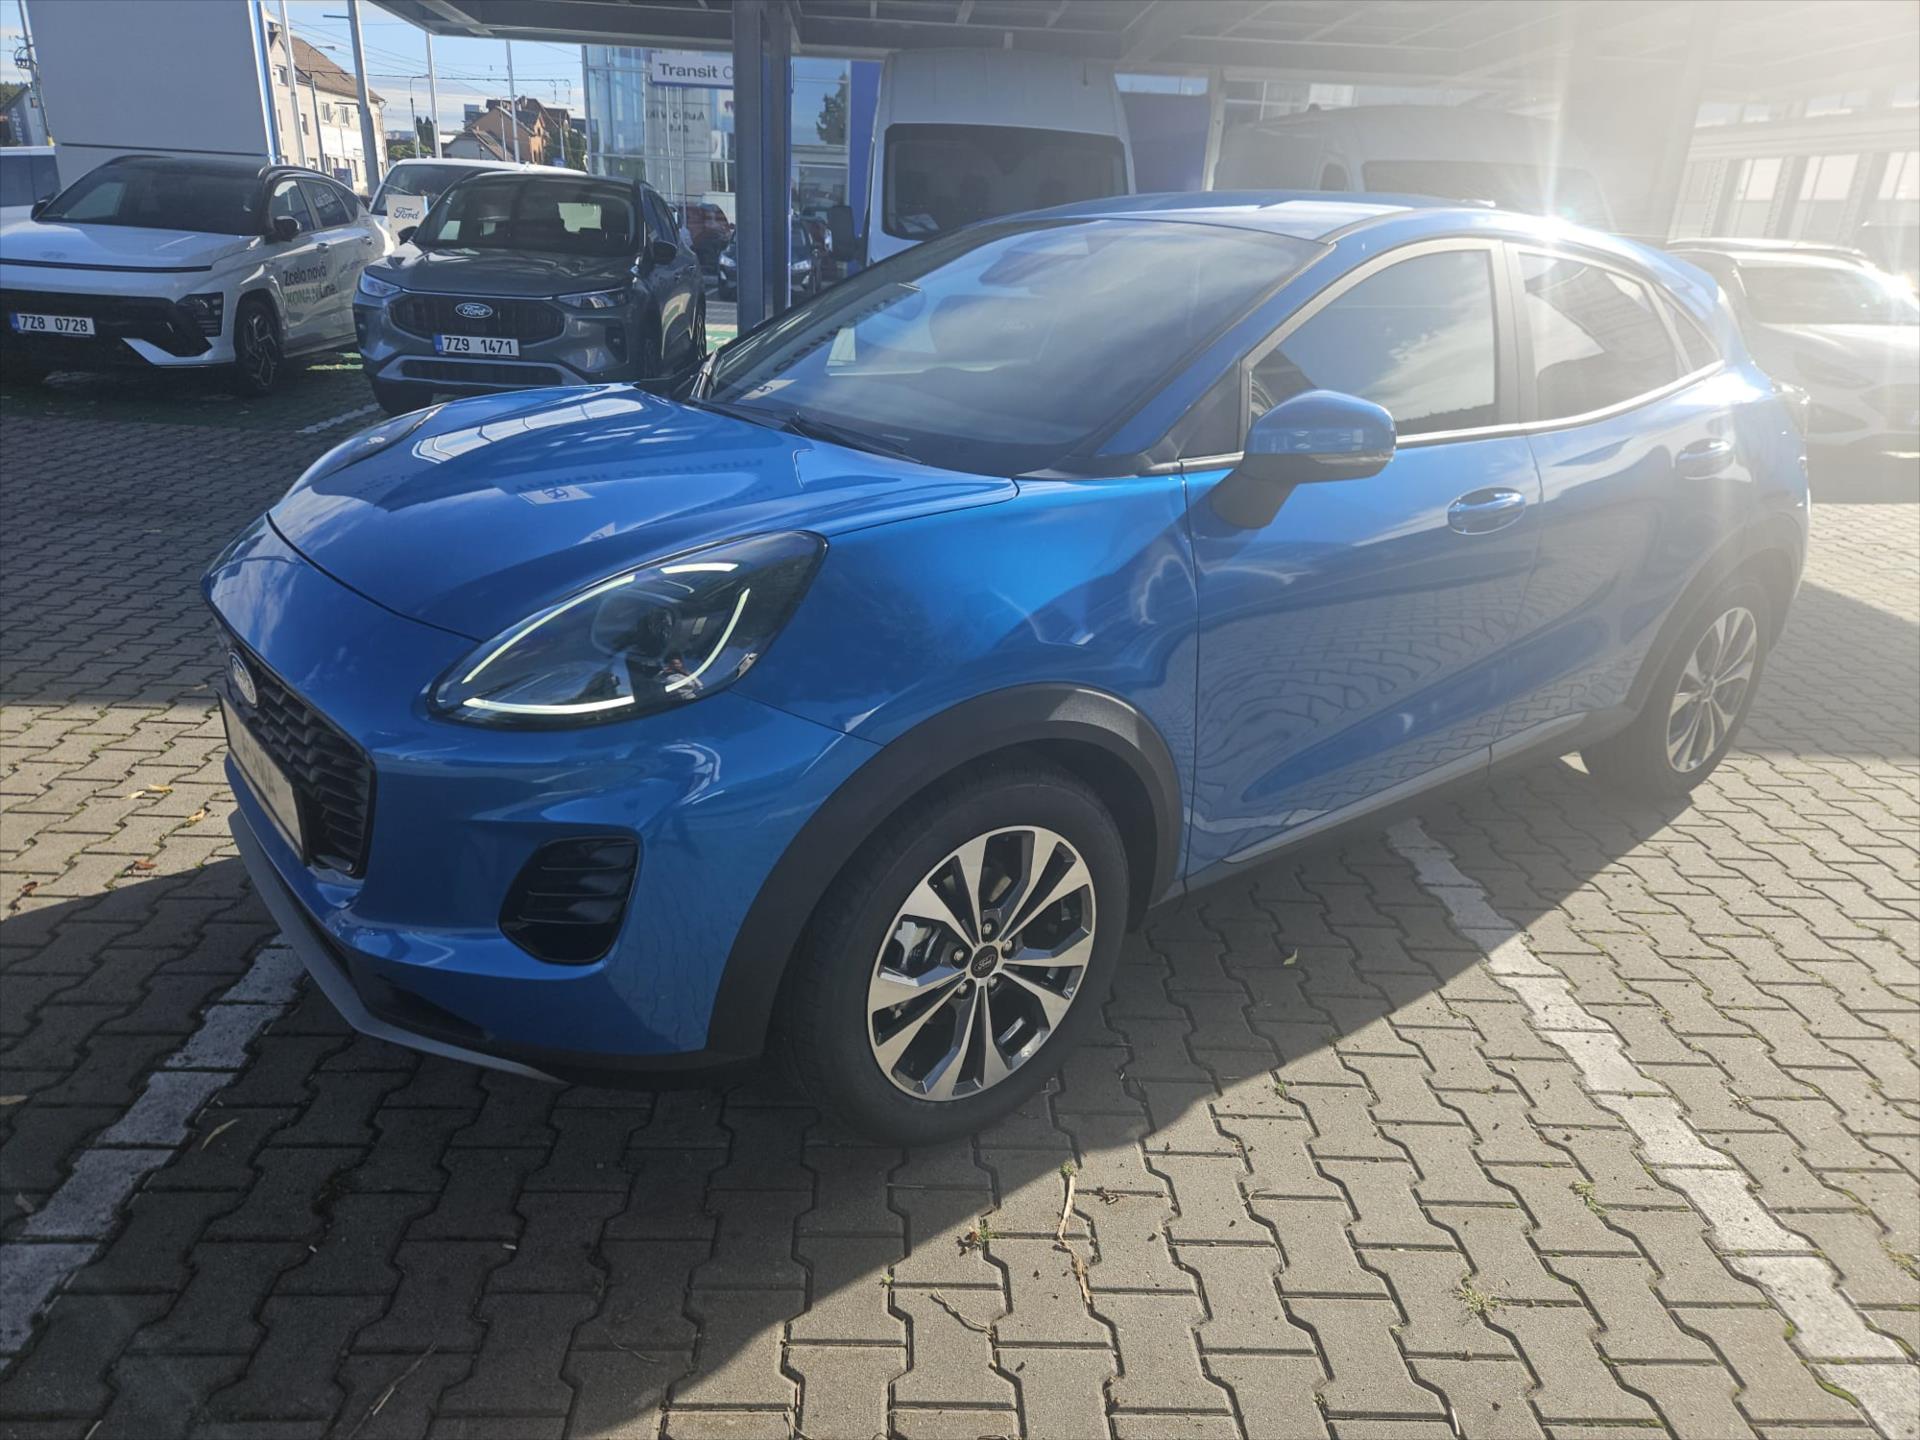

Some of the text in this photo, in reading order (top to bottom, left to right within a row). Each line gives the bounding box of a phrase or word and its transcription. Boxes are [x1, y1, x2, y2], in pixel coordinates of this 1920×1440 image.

[659, 63, 718, 79] Transit
[393, 206, 420, 220] Ford
[461, 303, 491, 316] Ford
[20, 315, 88, 333] 7Z8 0728
[444, 336, 512, 354] 7Z9 1471
